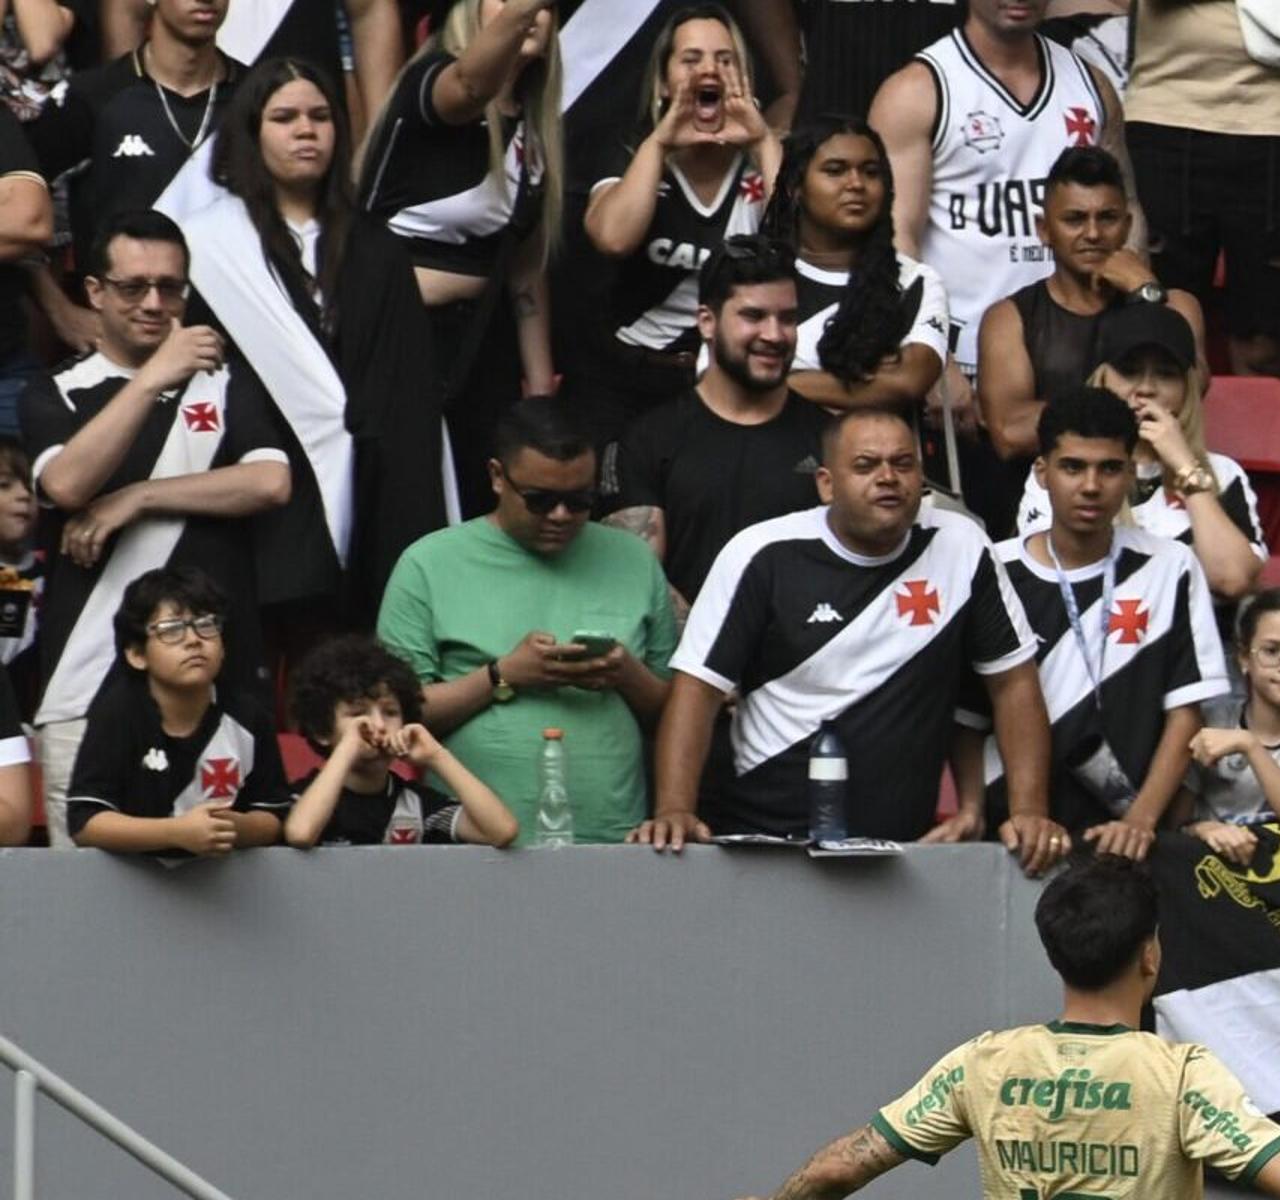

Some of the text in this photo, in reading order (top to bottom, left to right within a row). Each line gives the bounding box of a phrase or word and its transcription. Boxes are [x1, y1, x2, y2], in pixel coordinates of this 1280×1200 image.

[905, 1065, 965, 1126] crefia
[1000, 1068, 1131, 1121] crefisa
[1184, 1091, 1252, 1151] crefisa
[996, 1140, 1139, 1176] MAURICIO
